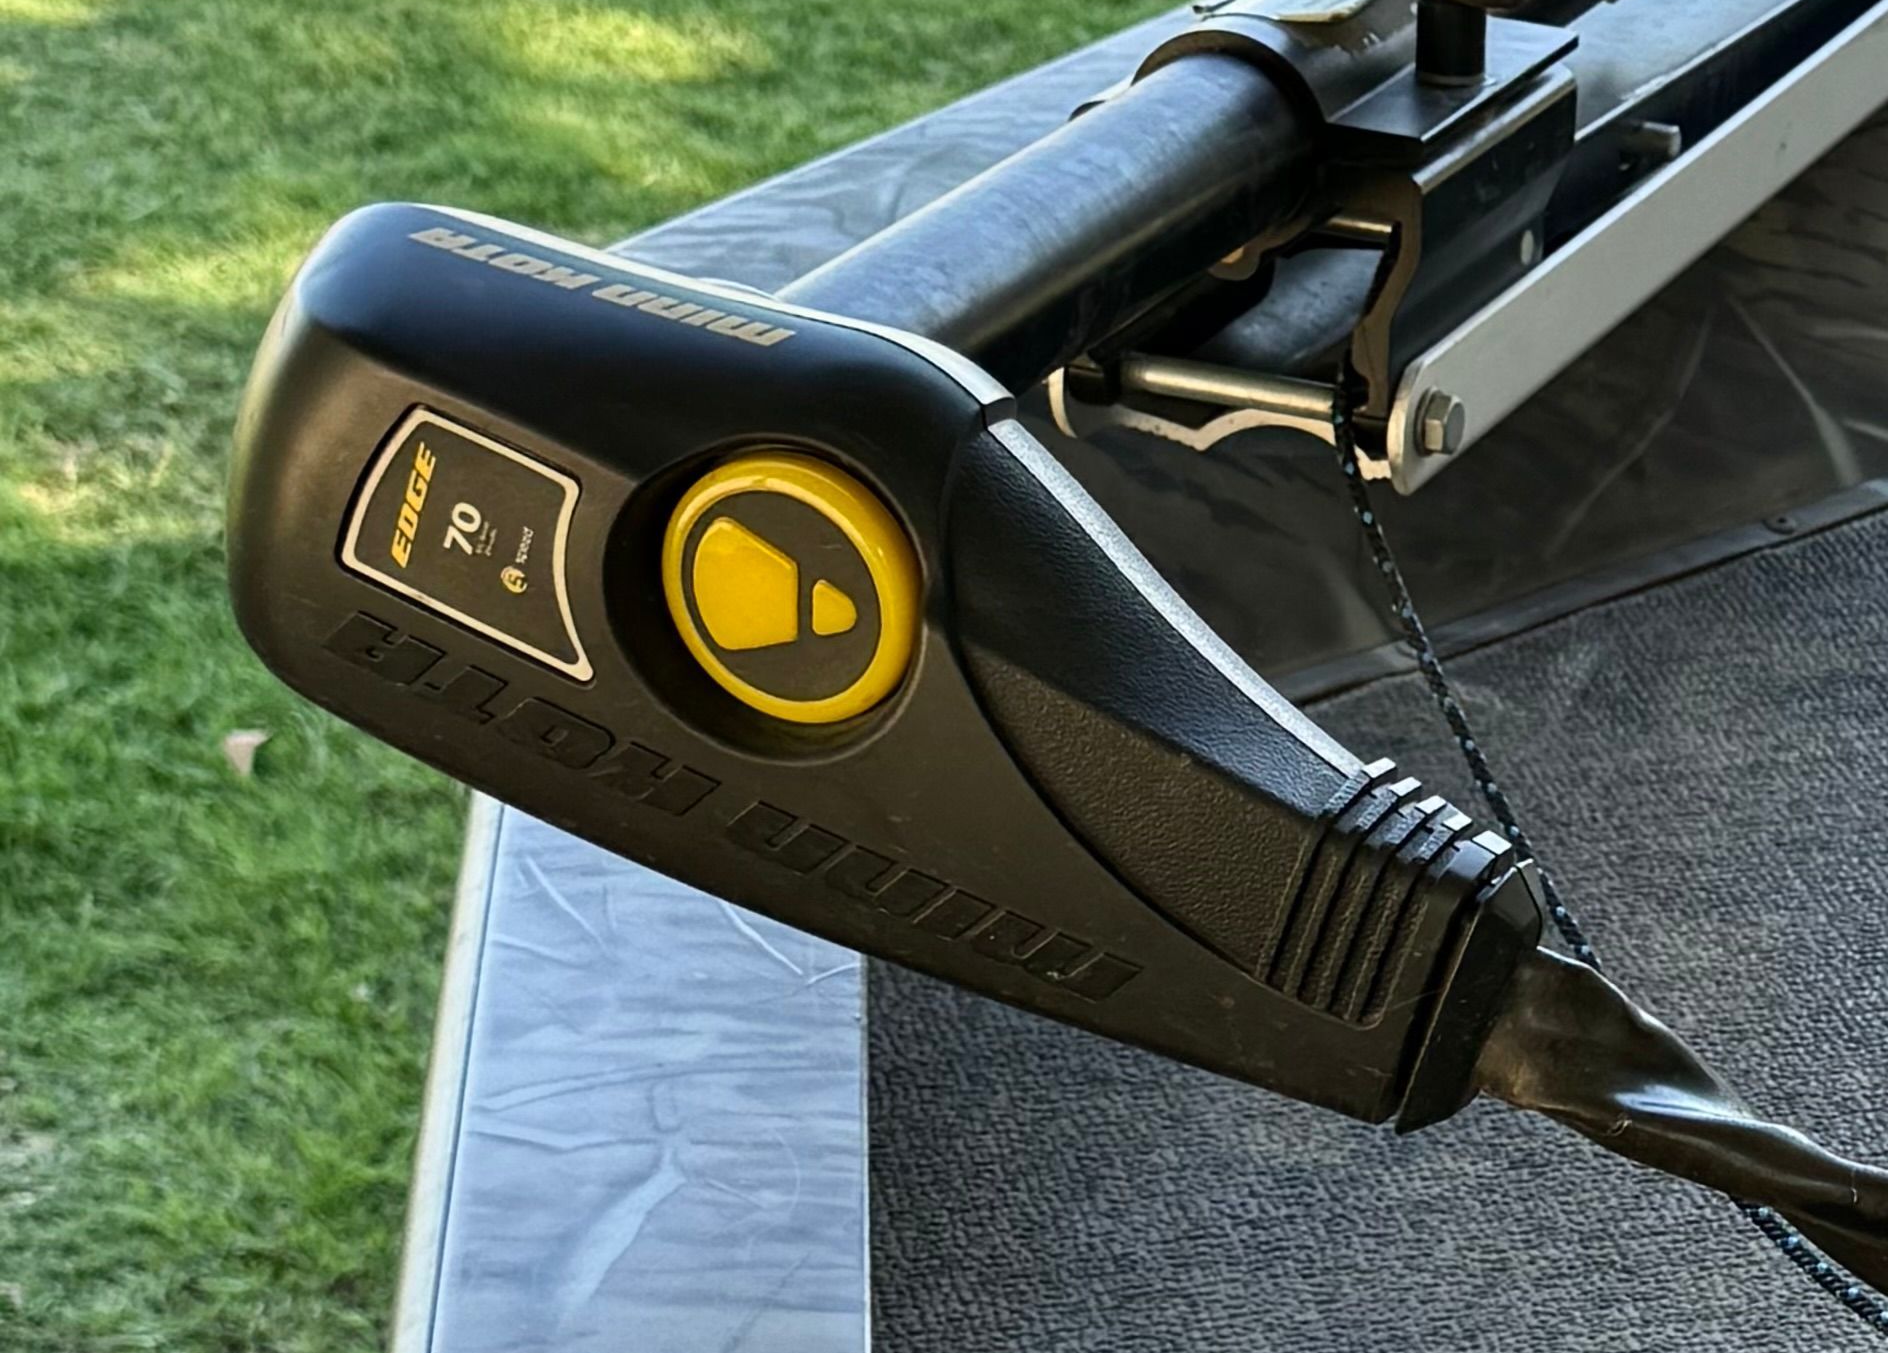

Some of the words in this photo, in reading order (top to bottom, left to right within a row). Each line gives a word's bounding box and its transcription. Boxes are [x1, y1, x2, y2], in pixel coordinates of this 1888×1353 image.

[409, 227, 601, 290] KOTA
[391, 441, 436, 568] EDGE
[443, 502, 482, 555] 70
[322, 610, 722, 817] KOTA
